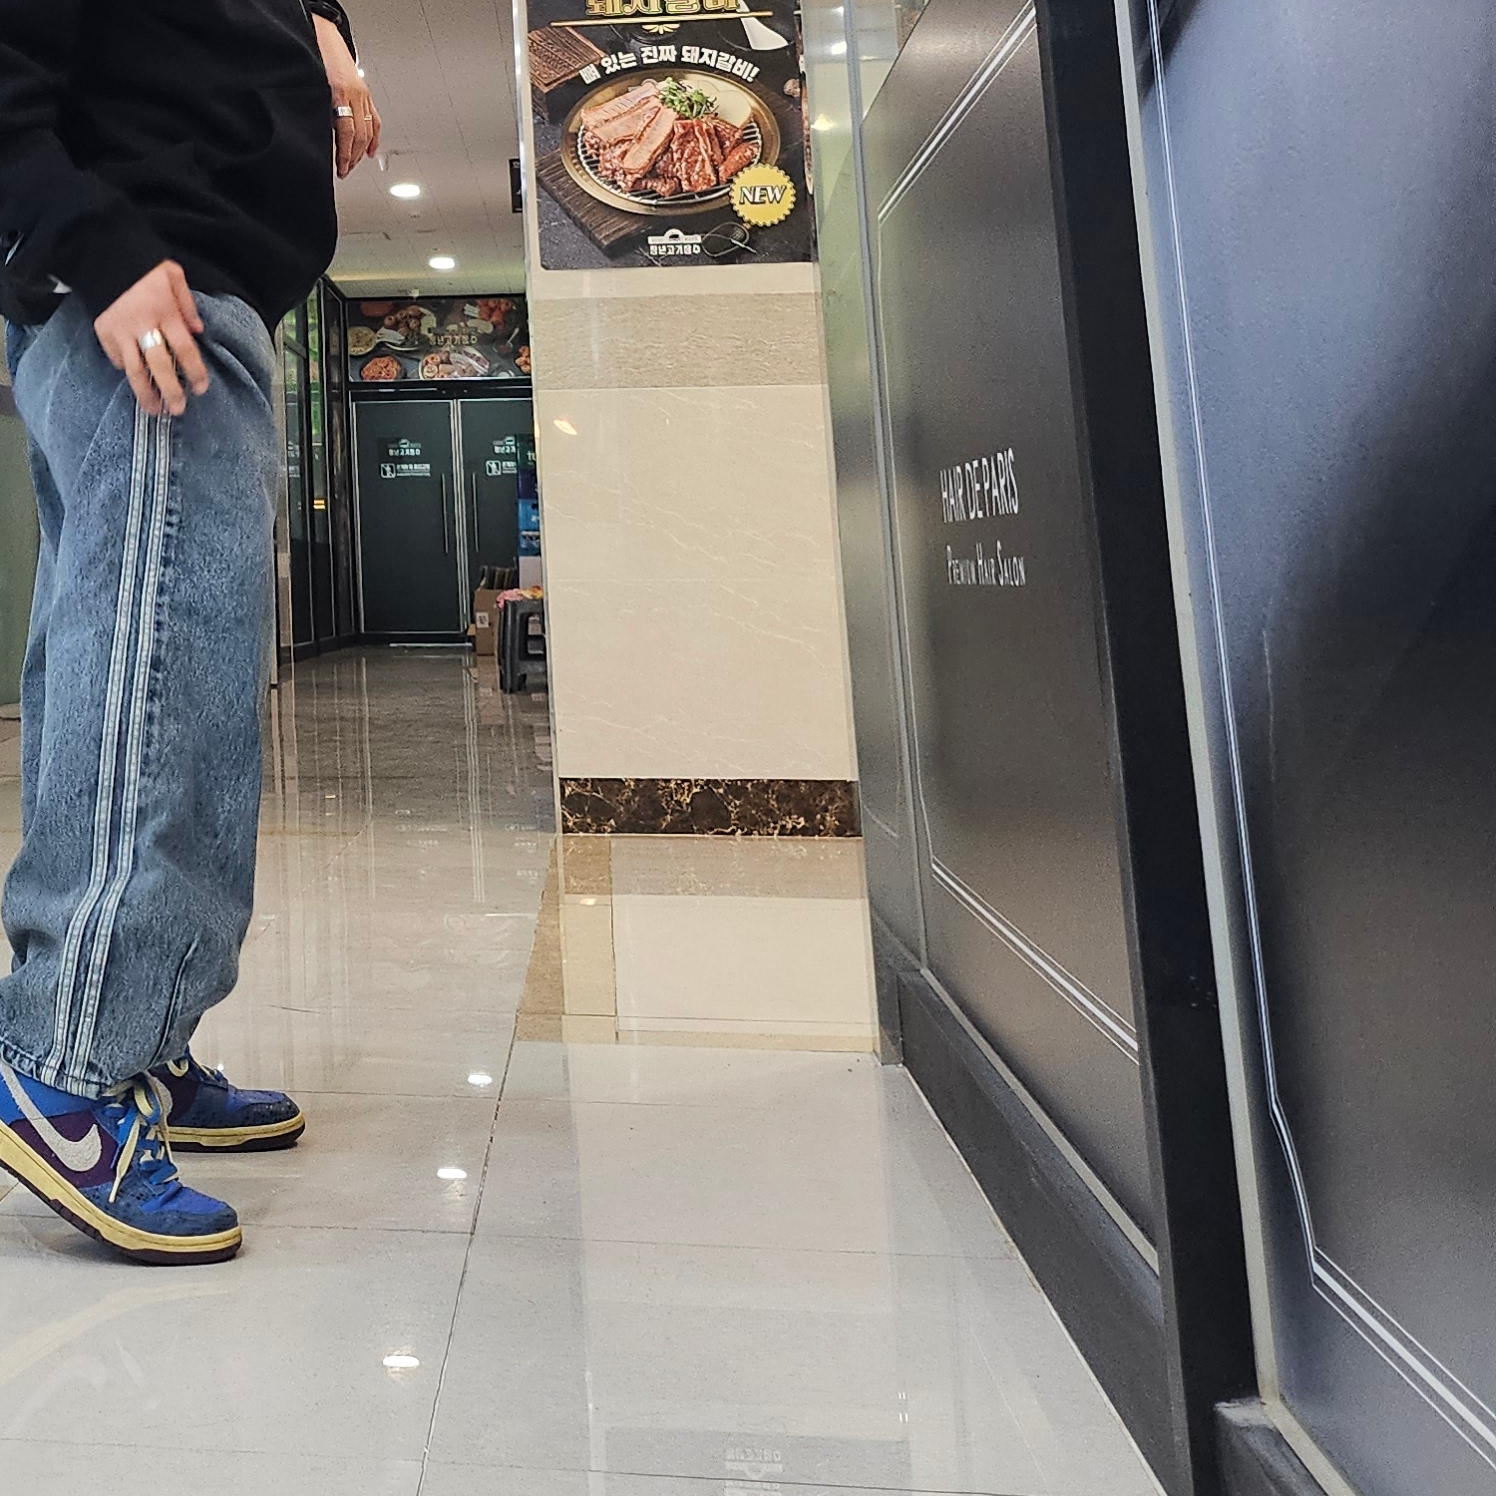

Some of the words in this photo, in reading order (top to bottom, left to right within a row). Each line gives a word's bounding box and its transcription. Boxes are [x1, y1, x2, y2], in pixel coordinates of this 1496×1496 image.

[601, 51, 638, 75] 있는
[640, 44, 678, 64] 진짜
[680, 45, 760, 83] 돼지갈비!
[739, 184, 787, 205] NEW
[965, 459, 984, 520] DE
[982, 447, 1019, 518] PARIS
